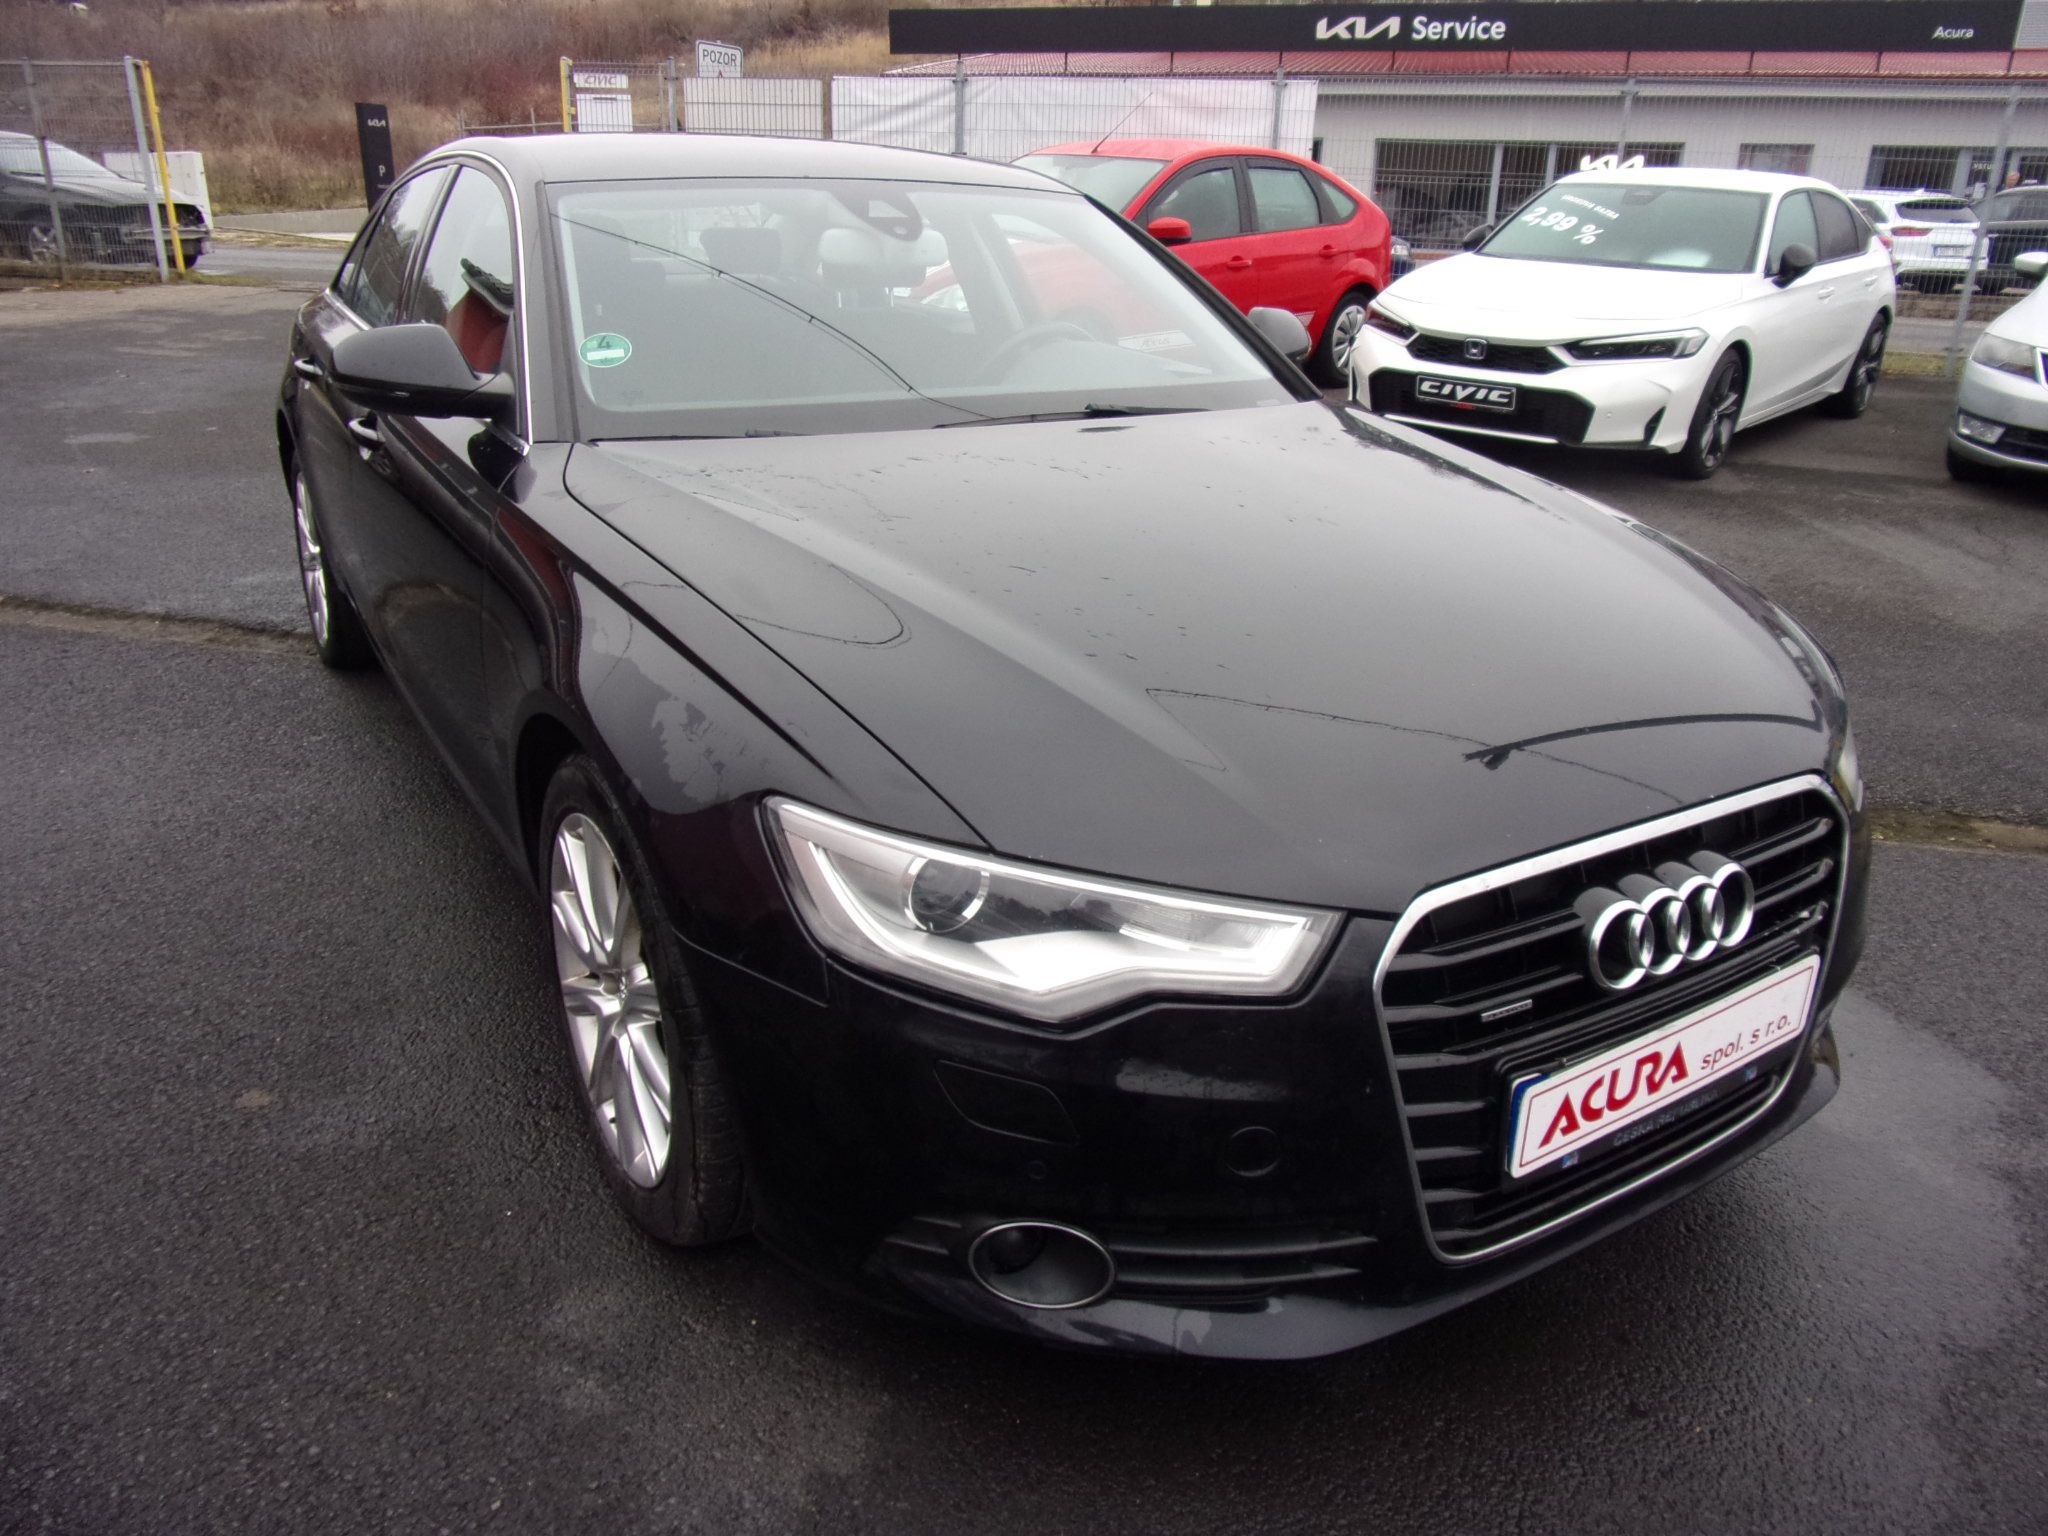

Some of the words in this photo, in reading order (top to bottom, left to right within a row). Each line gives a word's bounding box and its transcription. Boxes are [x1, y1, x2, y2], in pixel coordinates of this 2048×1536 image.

[1316, 16, 1400, 39] KIA
[1412, 15, 1506, 40] Service
[1932, 26, 1974, 39] Acura
[702, 49, 738, 67] POZOR
[1521, 206, 1579, 231] 2,99
[1572, 224, 1605, 245] %
[1420, 380, 1511, 403] CIVIC
[1538, 1040, 1689, 1149] ACURA
[1701, 1032, 1744, 1070] spol.
[1750, 1028, 1761, 1044] s
[1765, 1014, 1791, 1037] r.o.
